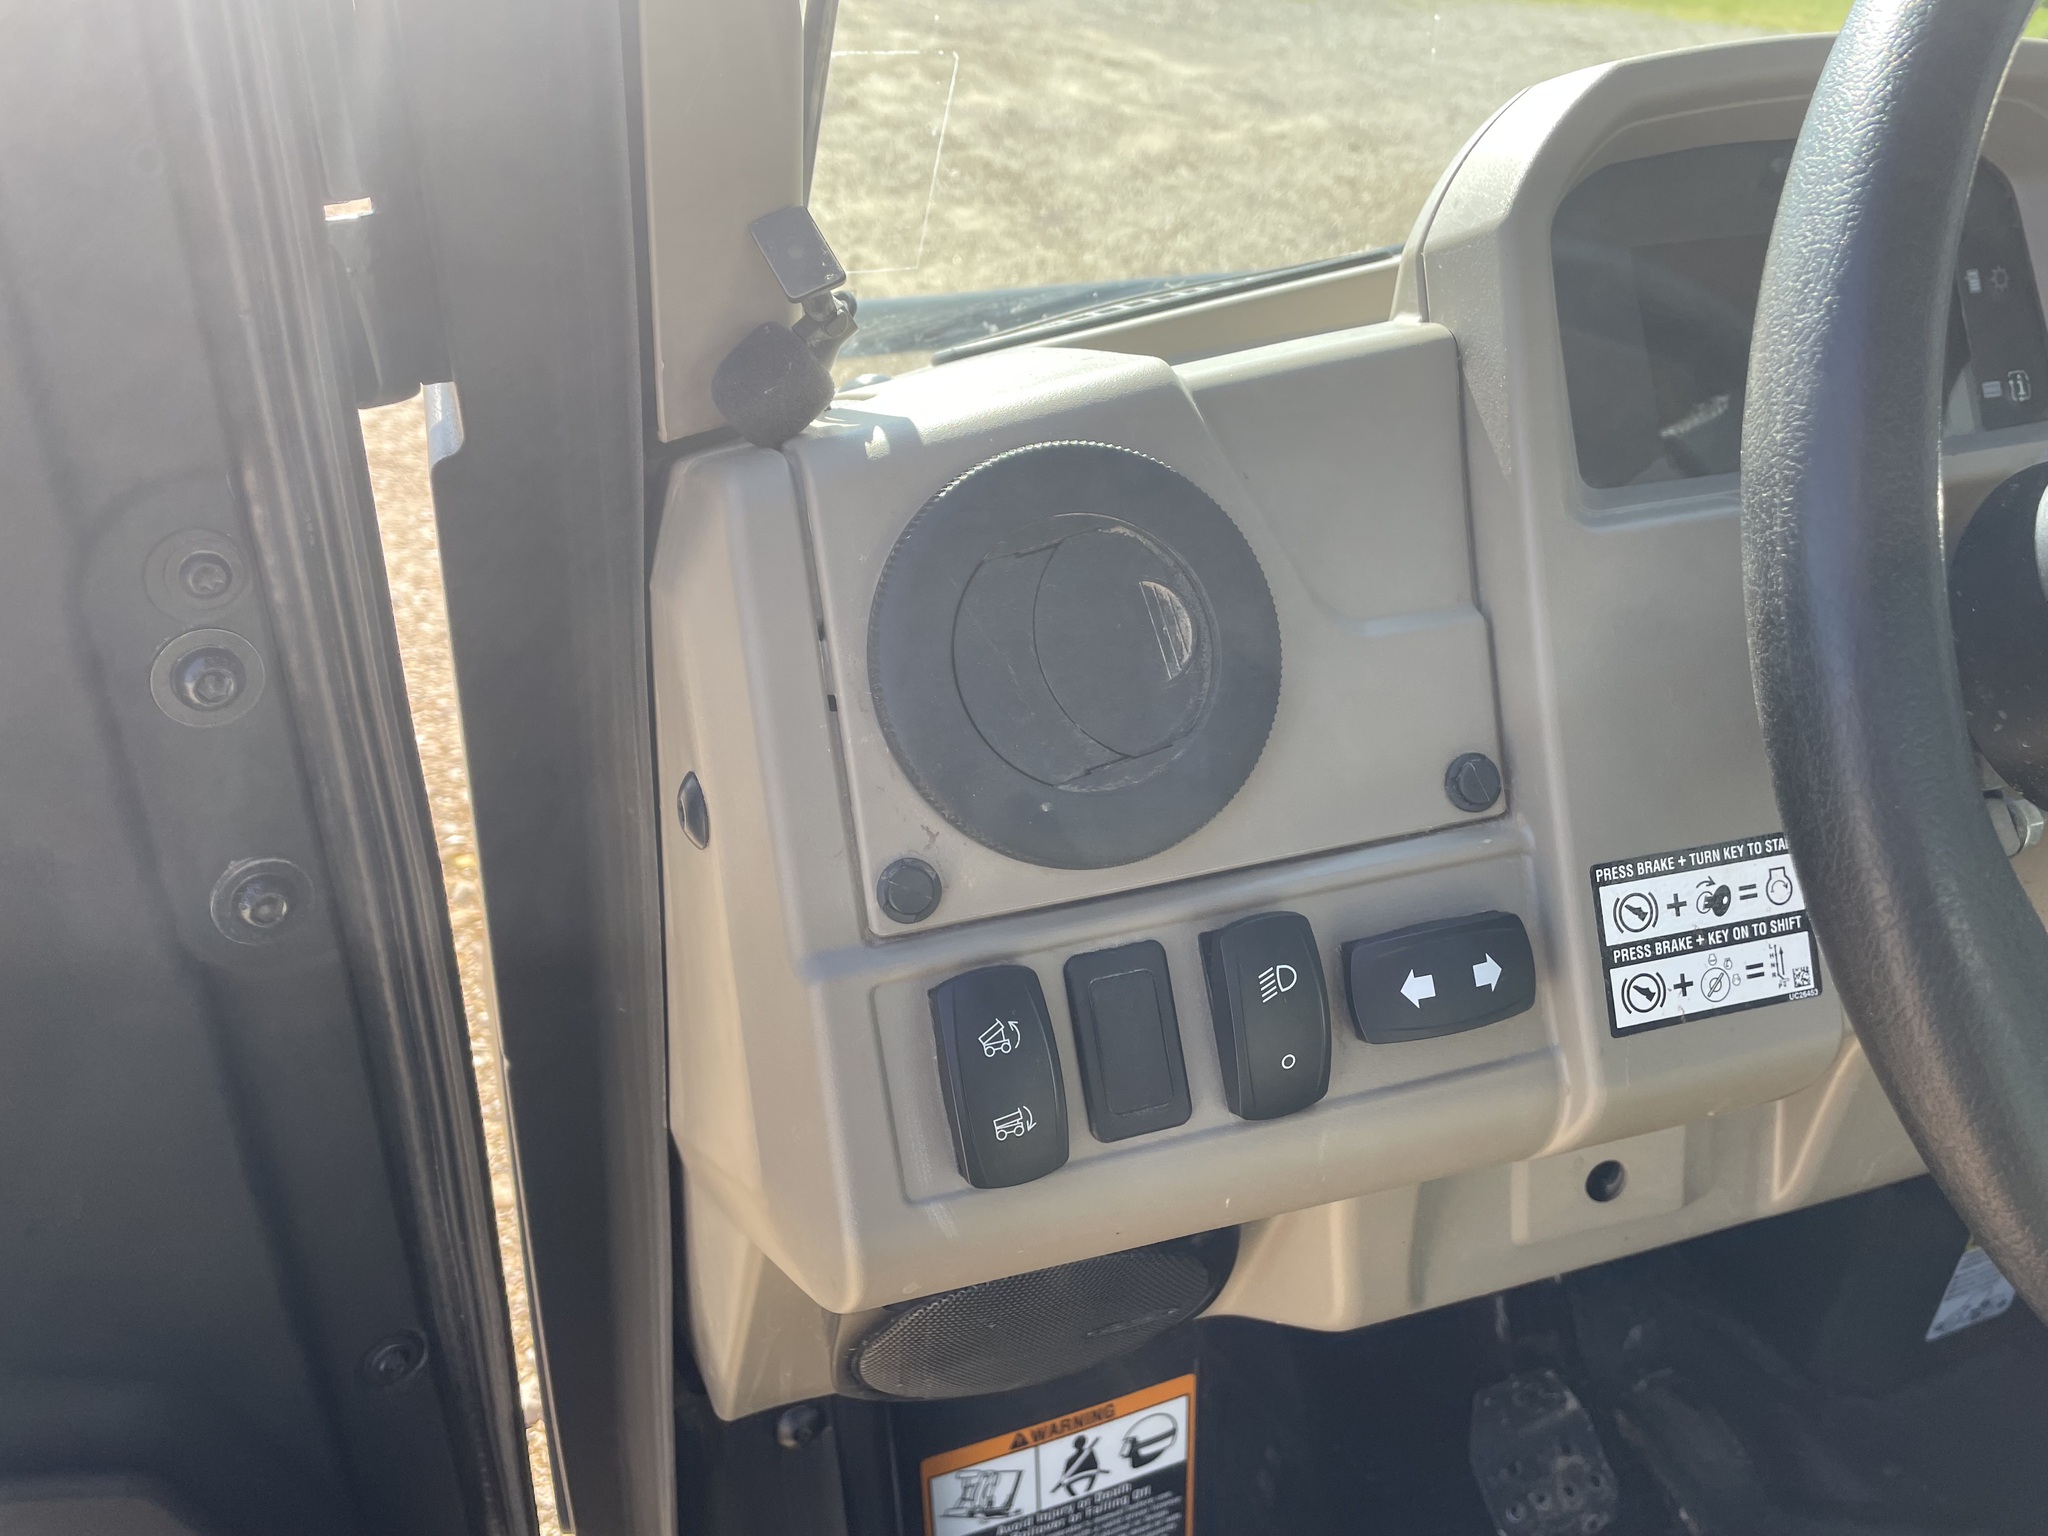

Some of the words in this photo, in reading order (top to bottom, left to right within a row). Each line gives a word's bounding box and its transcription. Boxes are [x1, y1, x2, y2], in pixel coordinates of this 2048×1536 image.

[1595, 864, 1634, 883] PRESS
[1637, 856, 1675, 875] BRAKE
[1689, 849, 1721, 867] TURN
[1723, 844, 1745, 859] KEY
[1747, 841, 1762, 856] TO
[1613, 943, 1651, 963] PRESS
[1654, 936, 1693, 956] BRAKE
[1707, 928, 1729, 944] KEY
[1732, 923, 1750, 939] ON
[1751, 920, 1768, 937] TO
[1770, 916, 1802, 934] SHIFT
[1030, 1402, 1115, 1443] WARNING
